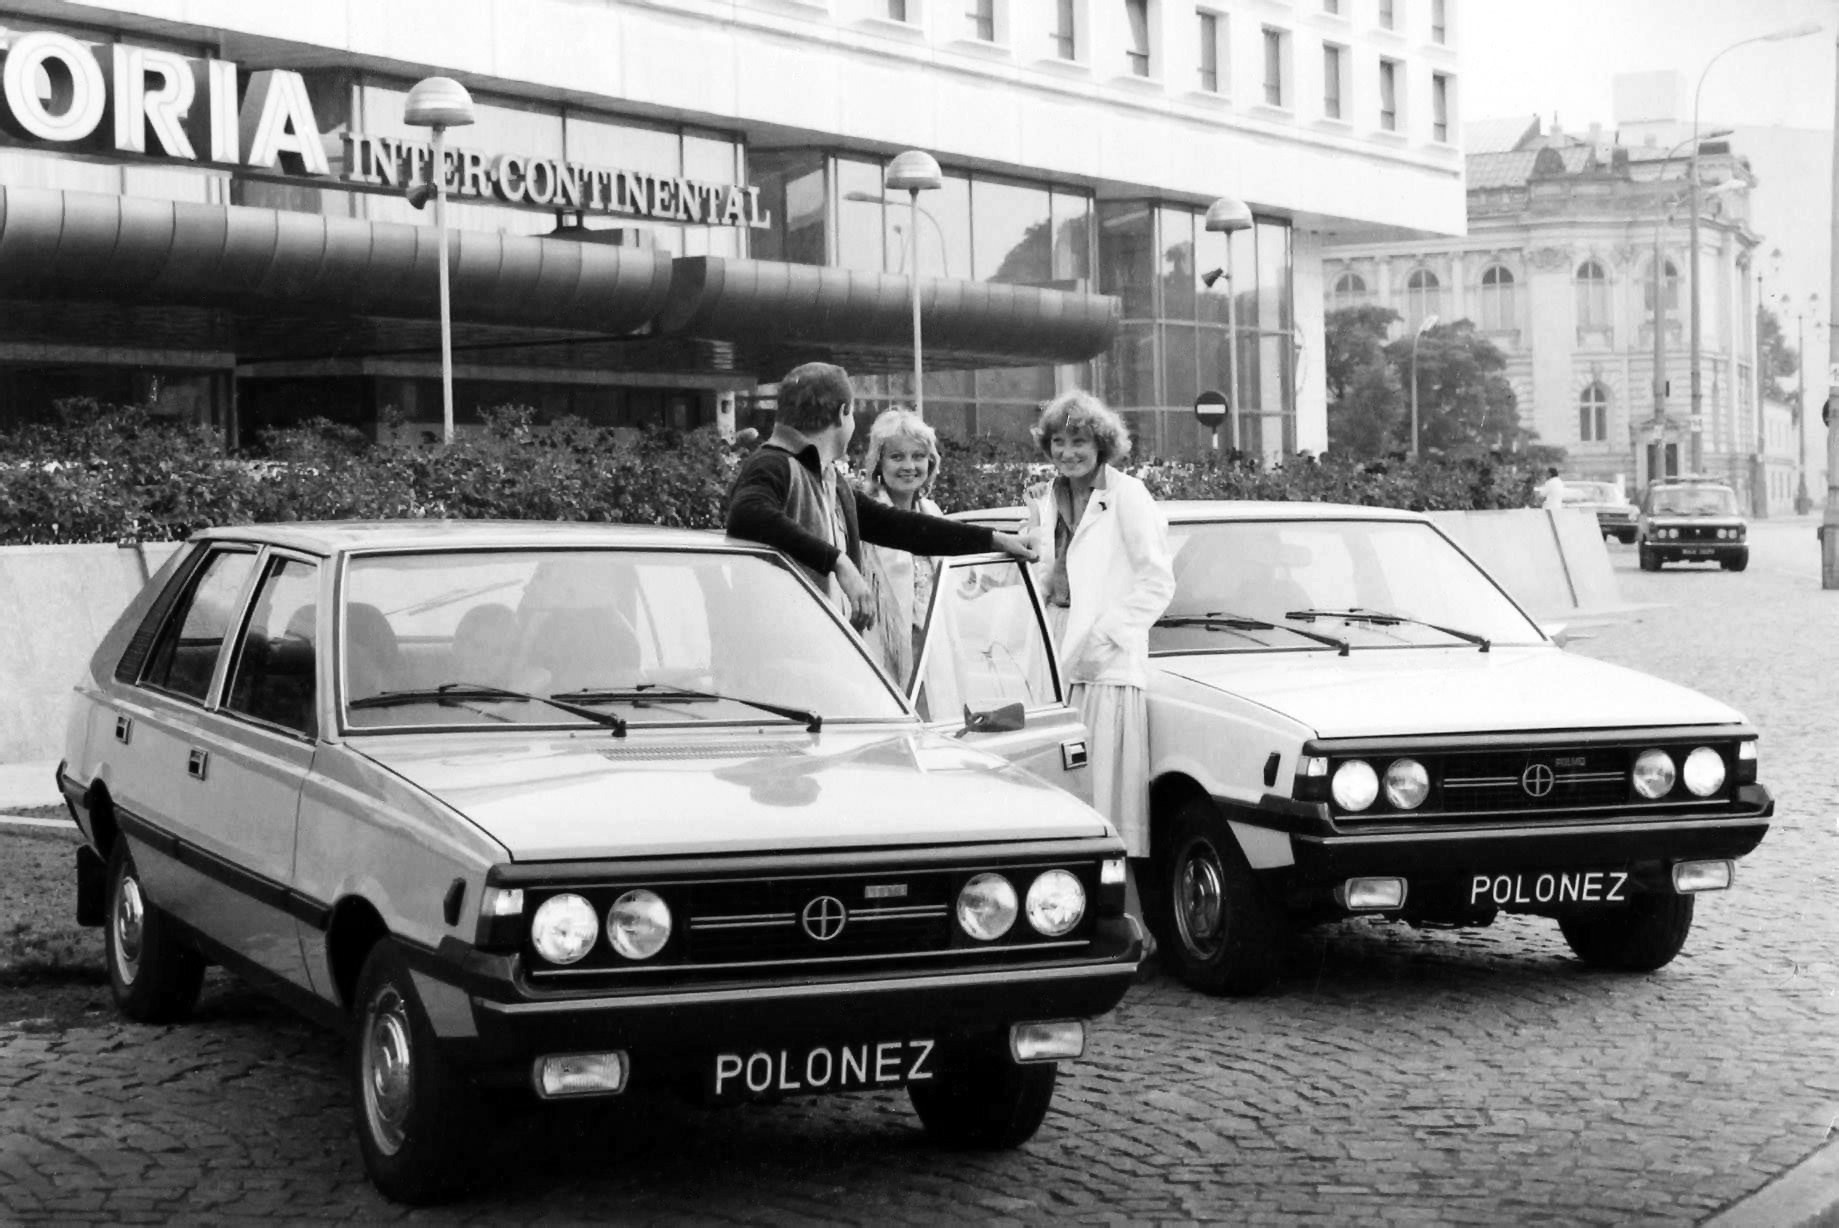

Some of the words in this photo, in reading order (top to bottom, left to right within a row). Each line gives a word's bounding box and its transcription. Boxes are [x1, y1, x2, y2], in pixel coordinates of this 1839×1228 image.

[0, 26, 331, 175] ORIA
[1471, 872, 1628, 905] POLONEZ
[715, 1039, 935, 1095] POLONEZ
